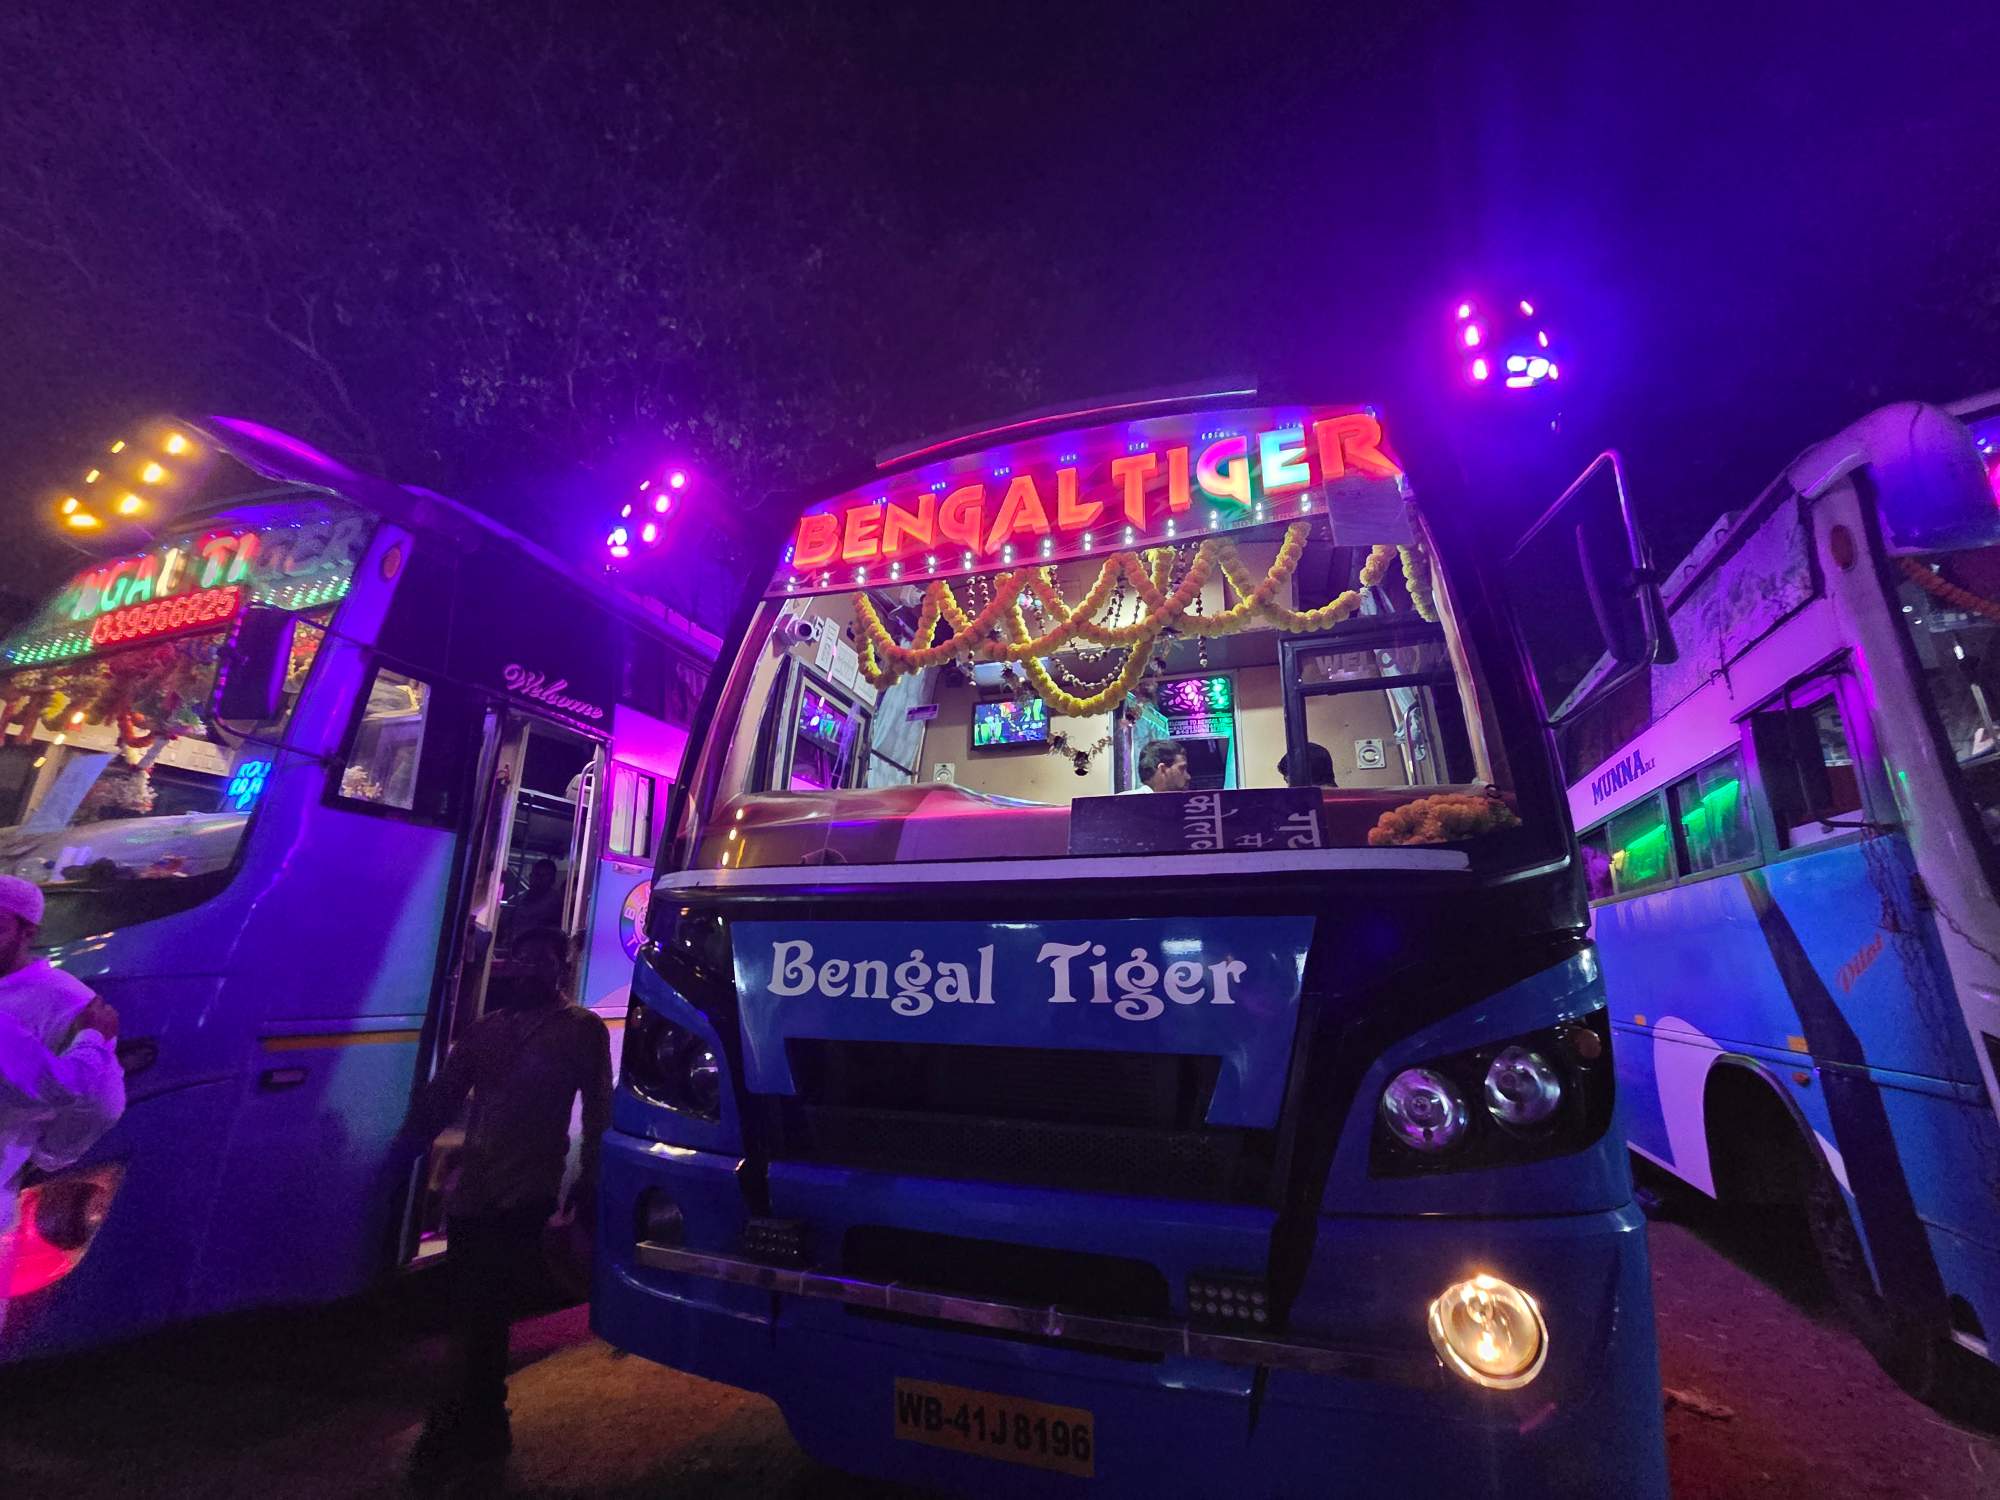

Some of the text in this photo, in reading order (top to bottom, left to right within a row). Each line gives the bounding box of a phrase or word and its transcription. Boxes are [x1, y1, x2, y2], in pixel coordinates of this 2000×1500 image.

[793, 412, 1401, 568] BENGAL TIGER
[504, 663, 604, 719] Welcome
[1592, 749, 1645, 806] MUNNA
[766, 939, 1248, 1022] Bengal Tiger
